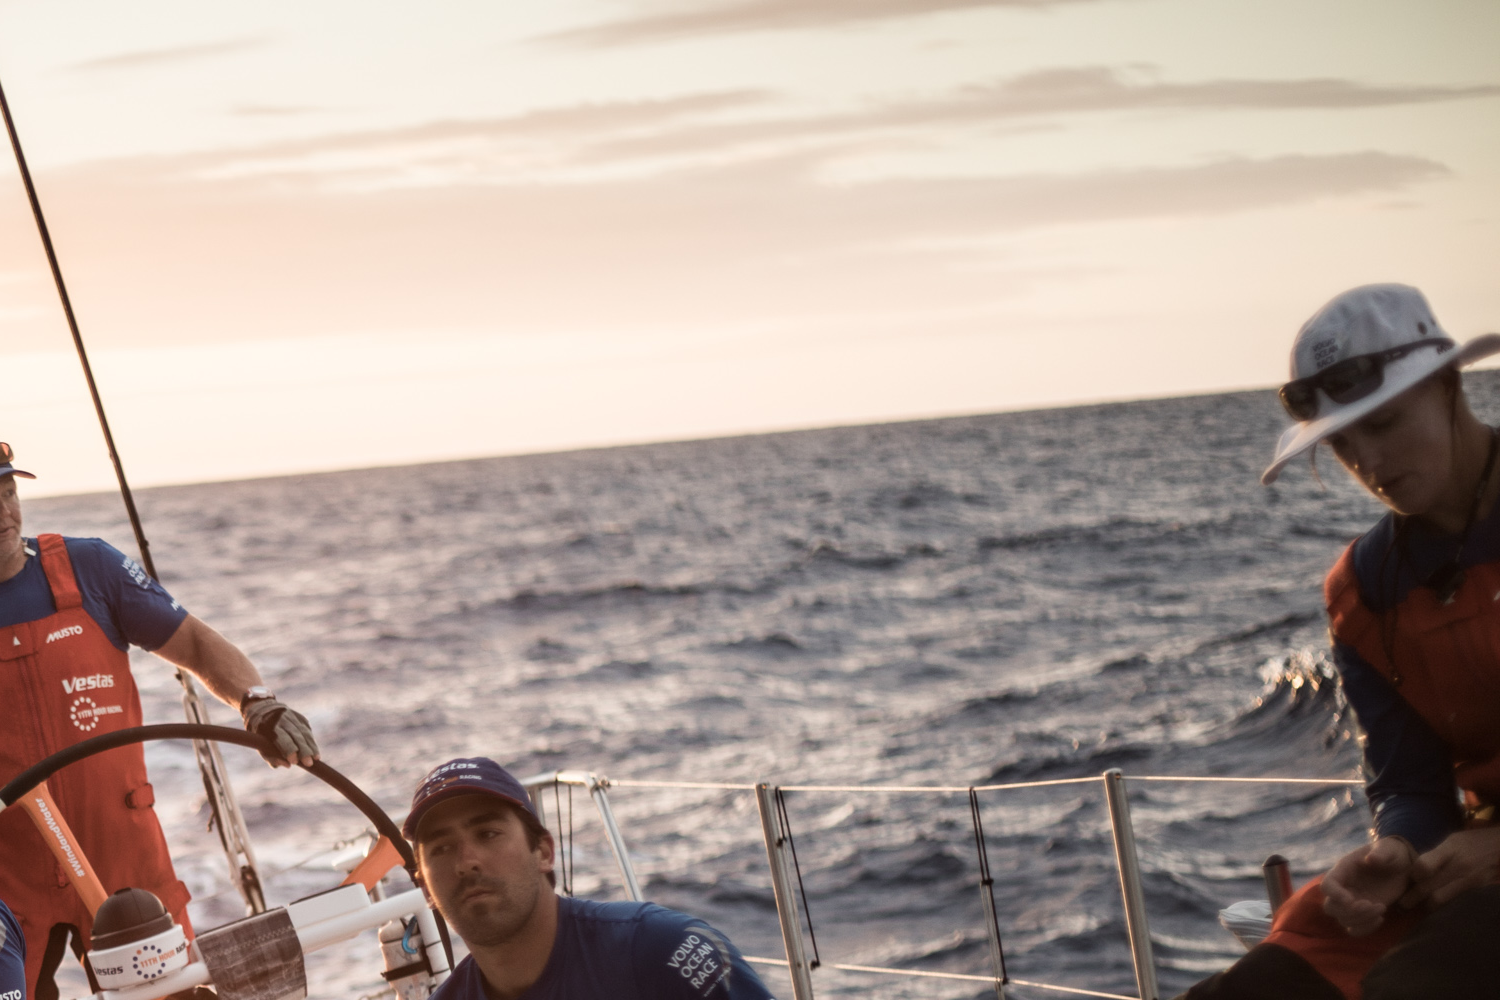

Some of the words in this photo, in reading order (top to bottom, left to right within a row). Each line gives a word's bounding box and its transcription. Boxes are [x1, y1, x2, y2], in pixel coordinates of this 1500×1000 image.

[46, 625, 83, 644] MUSTO
[61, 673, 115, 695] Vestas
[667, 934, 701, 969] VOLVO
[680, 942, 715, 979] OCEAN
[690, 957, 719, 990] RACE
